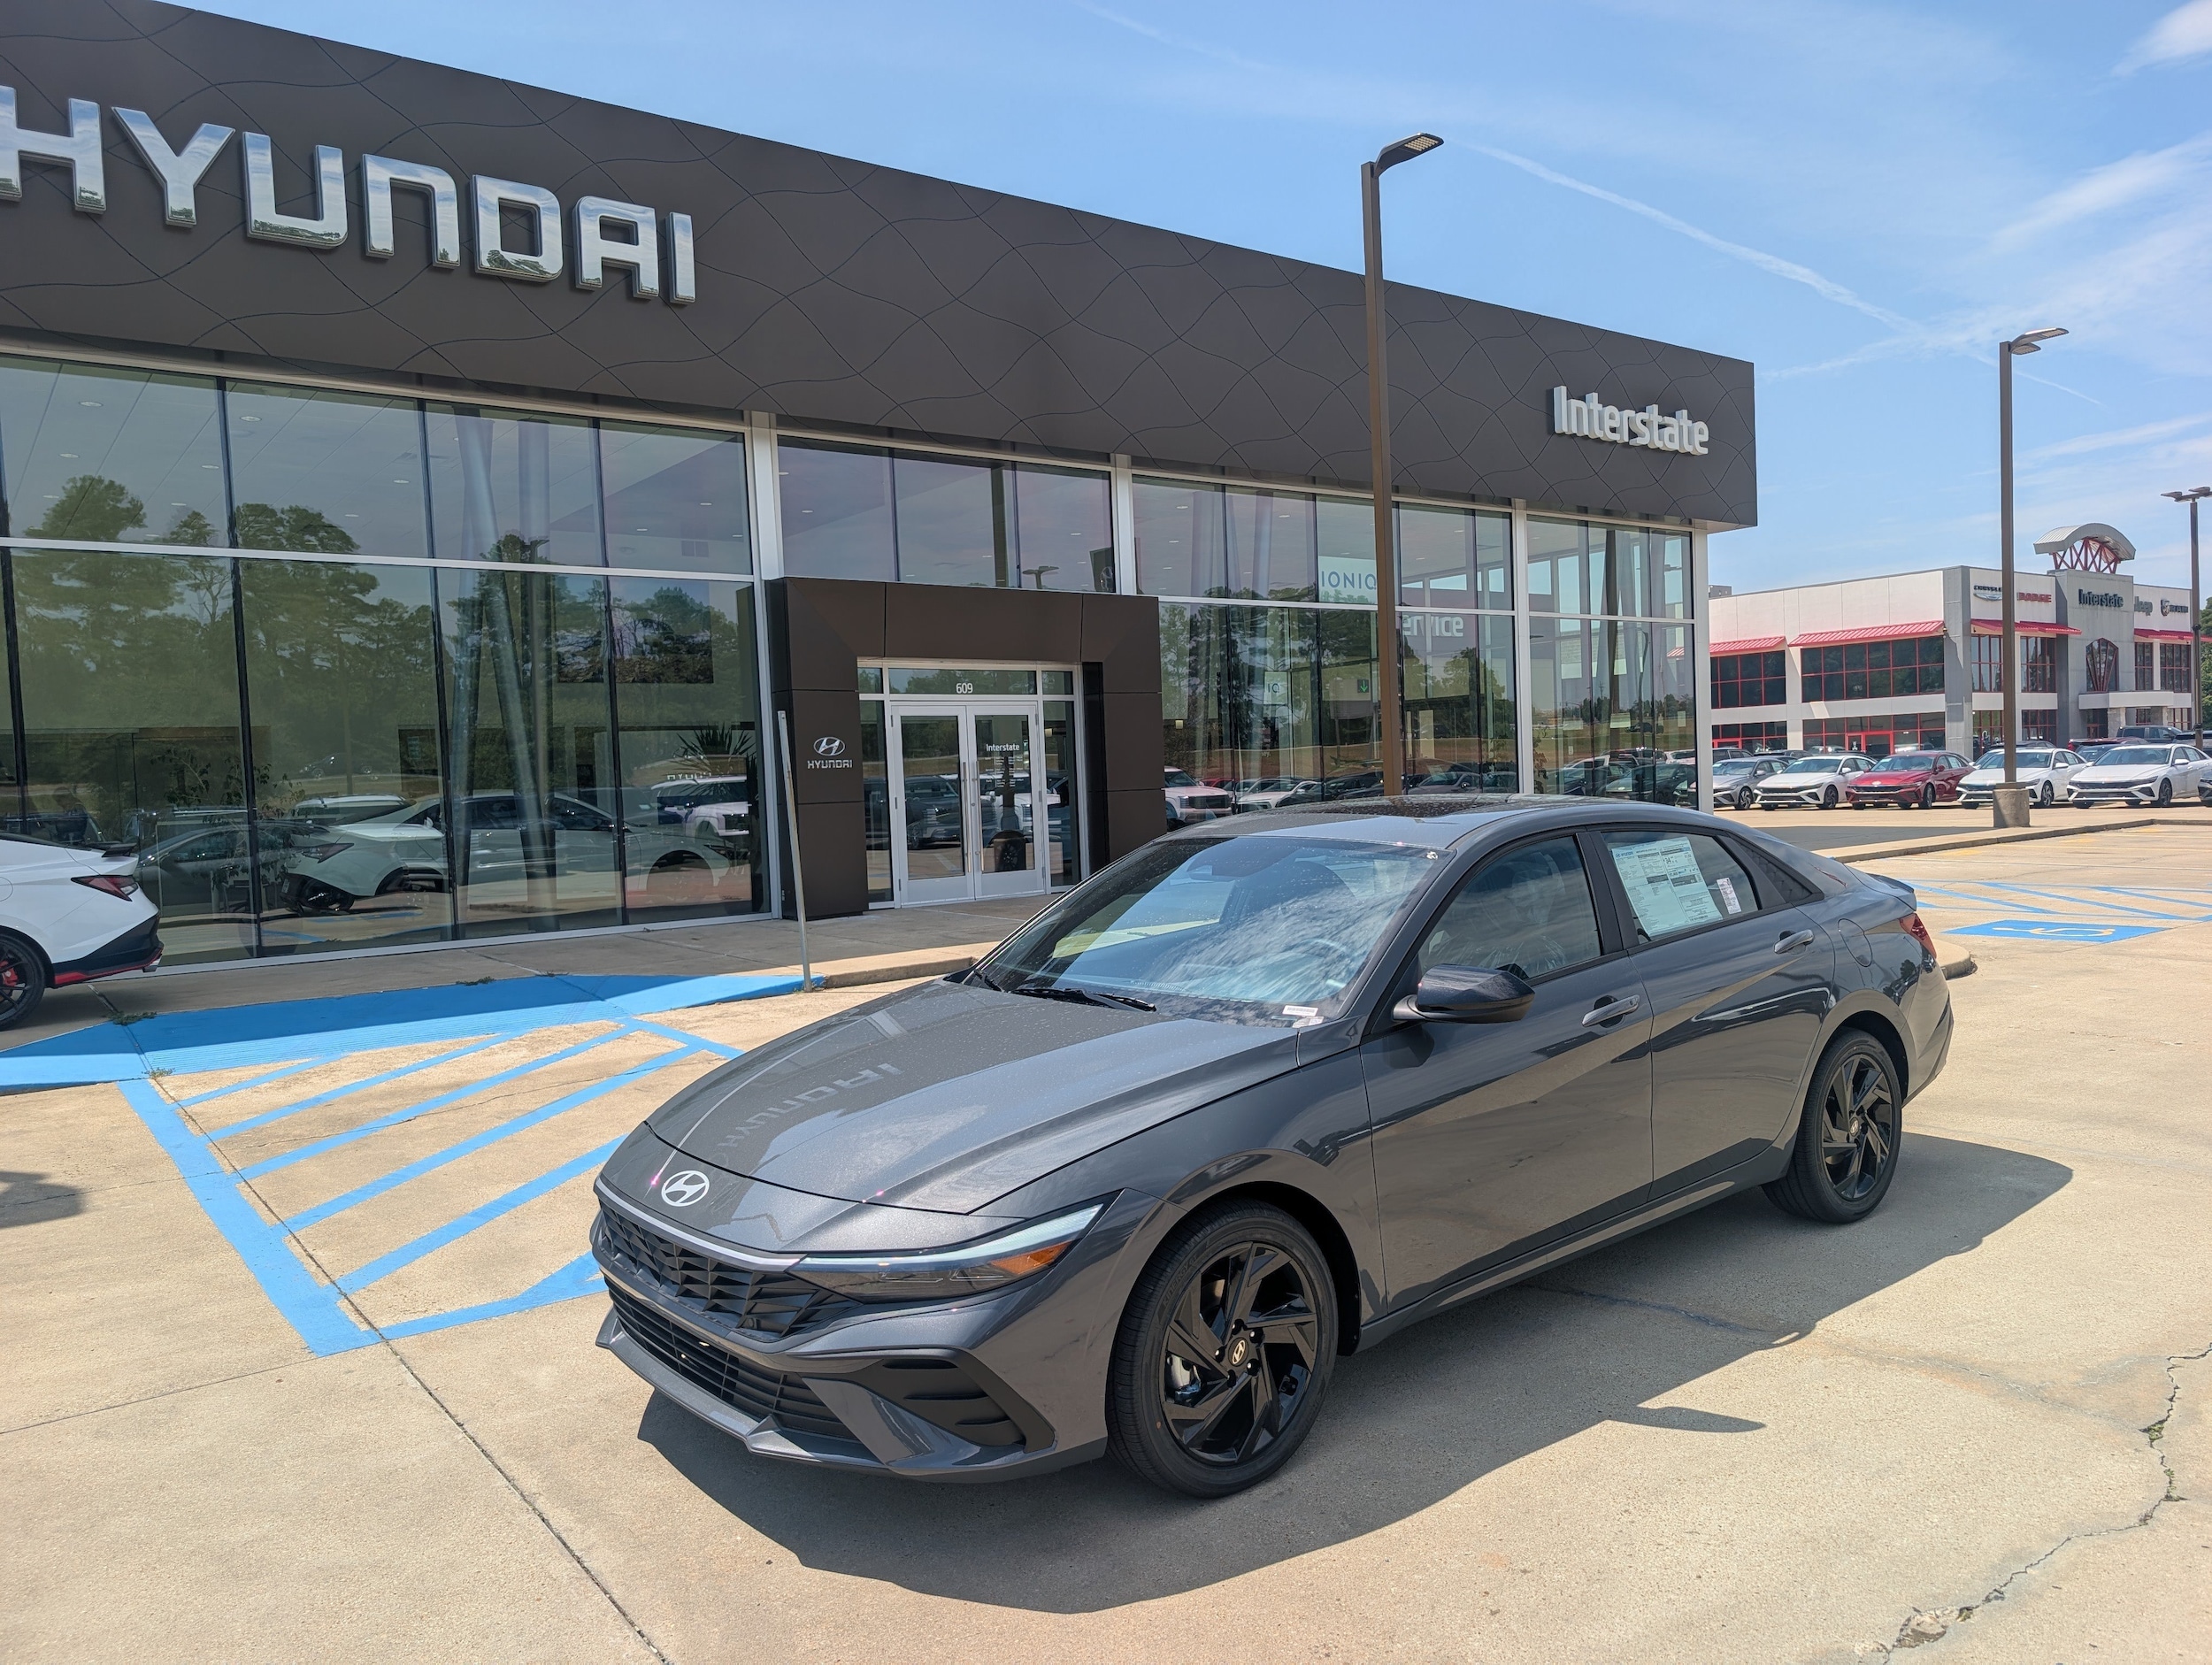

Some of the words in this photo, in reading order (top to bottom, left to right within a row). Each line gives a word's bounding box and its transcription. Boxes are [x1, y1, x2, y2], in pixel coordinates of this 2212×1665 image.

[0, 85, 696, 305] HYUNDAI
[1554, 386, 1709, 456] Interstate
[1321, 571, 1377, 590] IONIQ
[2016, 592, 2052, 602] DODGE
[2078, 588, 2124, 608] Interstate
[1402, 615, 1463, 637] ervice
[956, 683, 973, 694] 609
[986, 743, 1020, 752] Interstate
[807, 759, 853, 769] HYUNDAI
